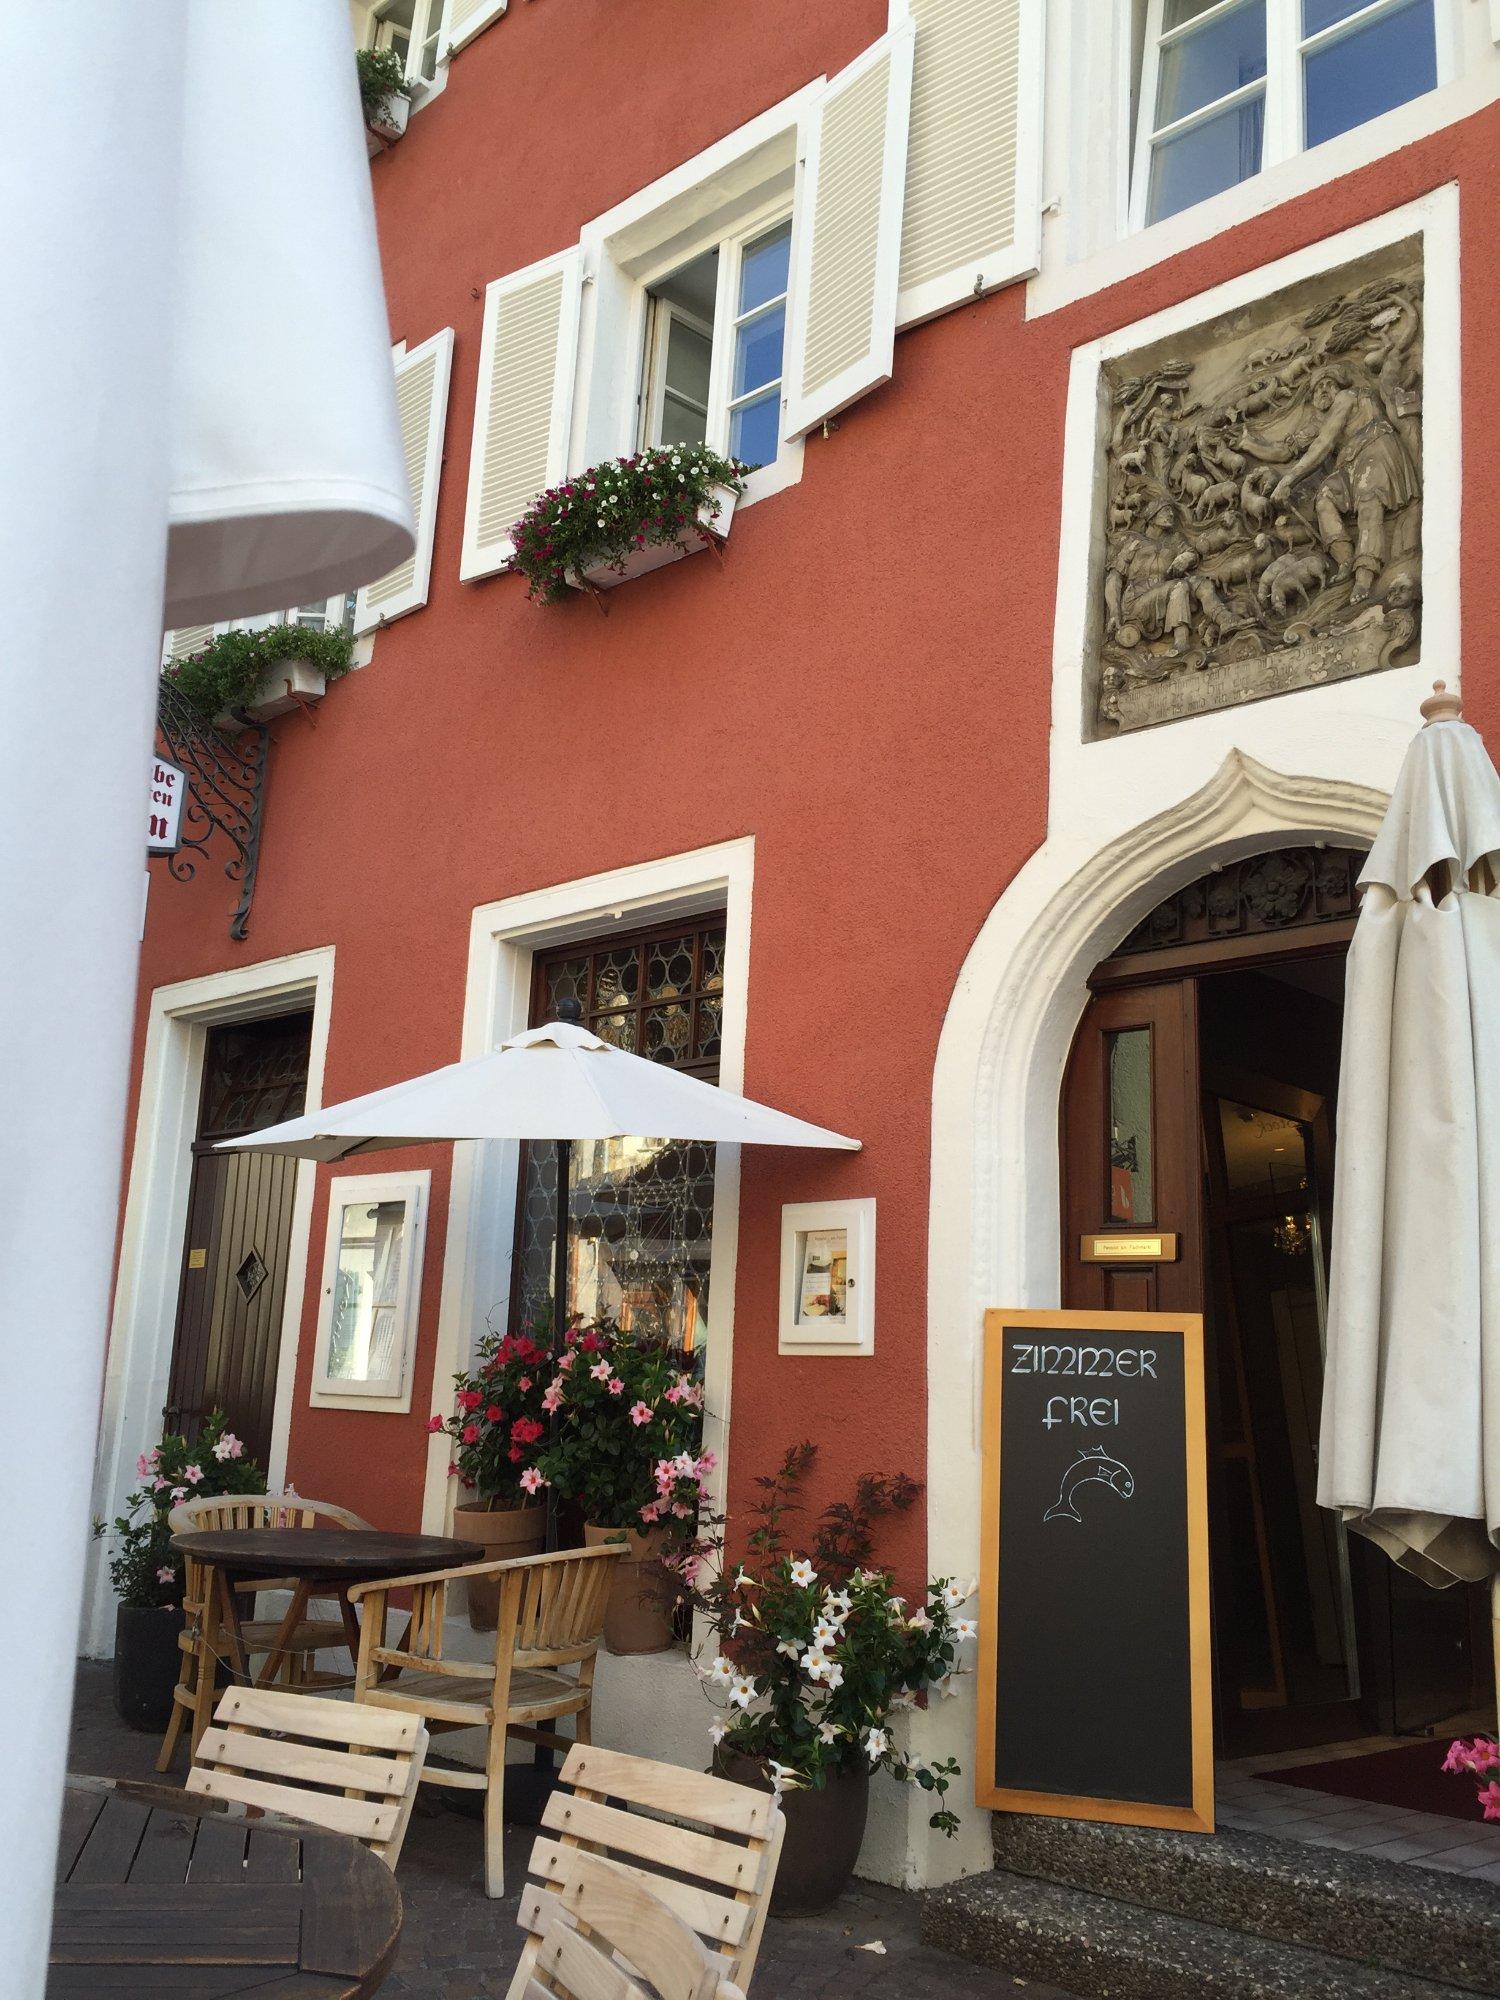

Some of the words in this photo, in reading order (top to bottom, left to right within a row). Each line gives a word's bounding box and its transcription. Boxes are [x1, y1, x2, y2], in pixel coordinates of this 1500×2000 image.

[153, 764, 175, 788] be
[152, 790, 172, 807] en
[149, 814, 169, 840] n
[1011, 1344, 1158, 1379] ZIMMER
[1042, 1396, 1119, 1430] FREI
